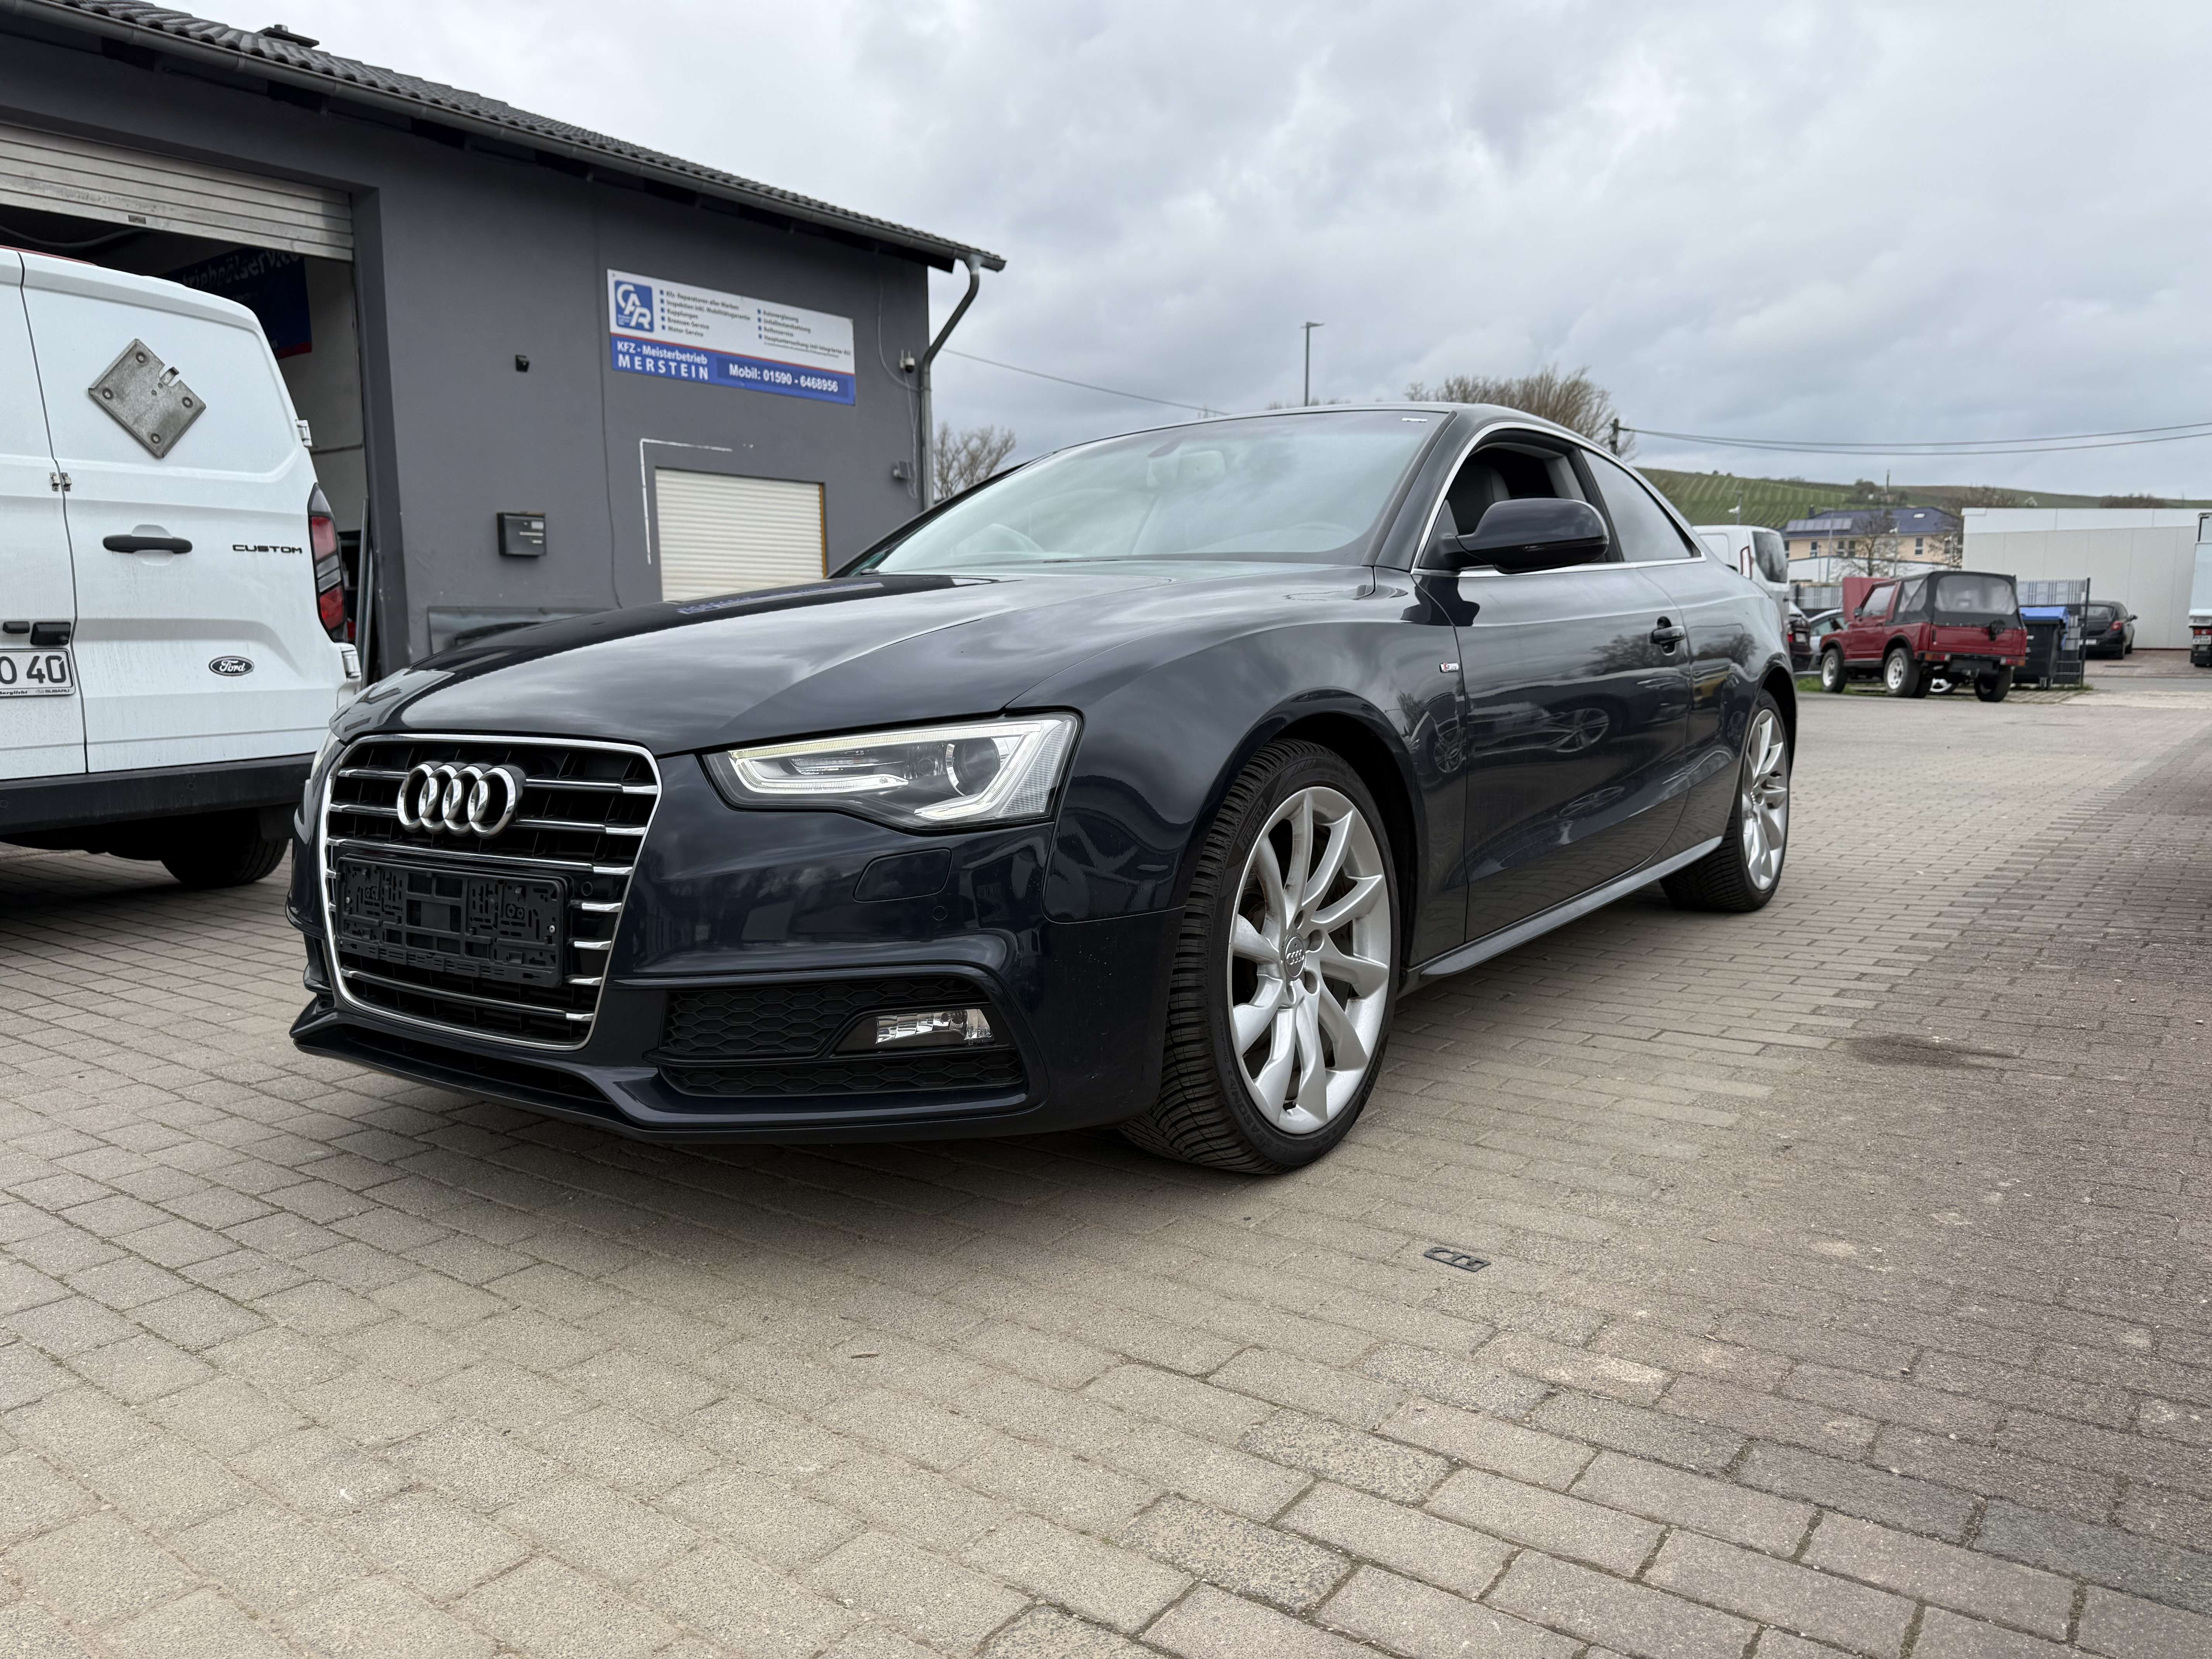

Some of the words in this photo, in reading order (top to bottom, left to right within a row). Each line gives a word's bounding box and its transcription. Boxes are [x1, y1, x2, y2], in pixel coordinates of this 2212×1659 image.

[617, 284, 651, 330] CAR
[617, 340, 636, 354] KFZ
[642, 344, 708, 365] Meisterbetrieb
[618, 354, 709, 380] MERSTEIN
[729, 363, 761, 380] Mobil:
[763, 369, 792, 385] 01590
[233, 544, 302, 554] CUSTOM
[26, 655, 66, 684] 40
[219, 660, 246, 672] Ford
